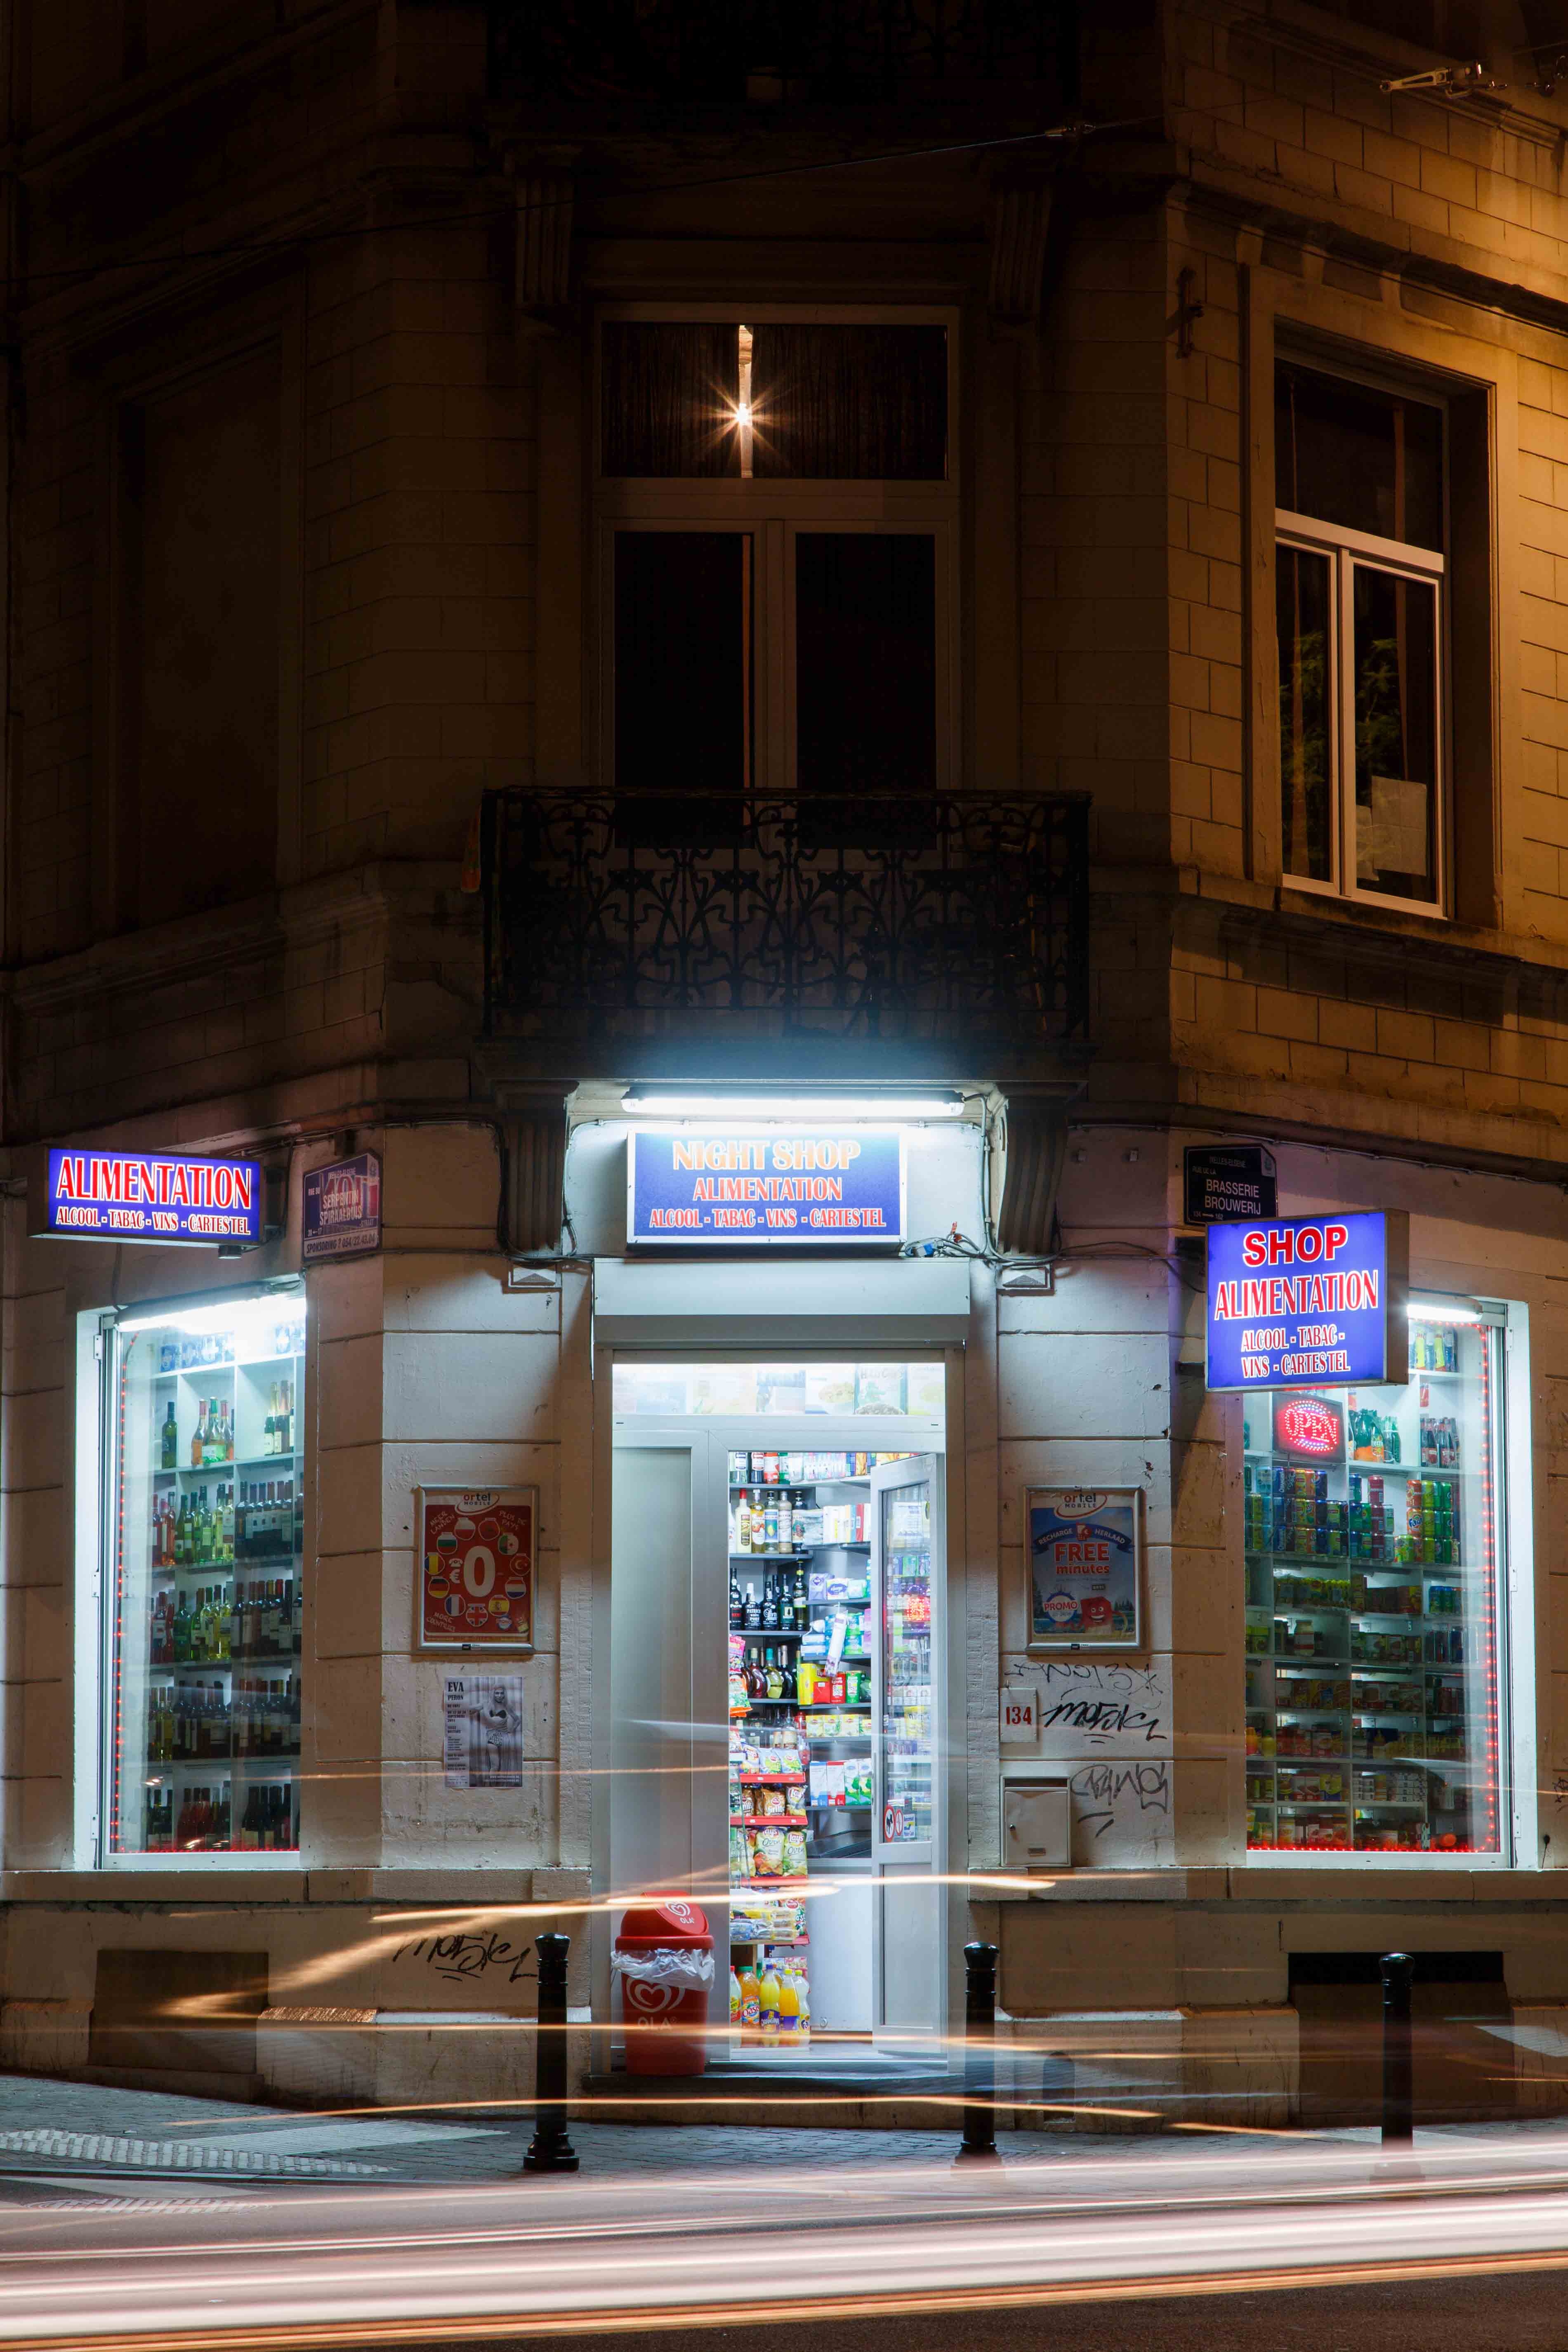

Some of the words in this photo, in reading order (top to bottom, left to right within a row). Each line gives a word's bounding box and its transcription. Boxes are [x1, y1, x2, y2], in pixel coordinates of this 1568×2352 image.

[673, 1139, 773, 1170] NIGHT
[773, 1139, 861, 1170] SHOP
[56, 1156, 251, 1210] ALIMENTATION
[693, 1176, 842, 1201] ALIMENTATION
[1206, 1179, 1259, 1198] BRASSERIE
[323, 1189, 359, 1209] SERPENTIN
[1205, 1195, 1261, 1215] BROUWERIJ
[56, 1206, 101, 1226] ALCOOL
[109, 1210, 144, 1228] TABAC
[152, 1212, 179, 1231] VINS
[649, 1208, 703, 1228] ALCOOL
[712, 1208, 756, 1228] TABAC
[766, 1208, 797, 1228] VINS
[307, 1239, 337, 1254] SPONSORING
[1242, 1224, 1349, 1267] SHOP
[1214, 1269, 1379, 1321] ALIMENTATION
[1240, 1327, 1289, 1352] ALCOOL
[1297, 1324, 1337, 1348] TABAC
[1241, 1355, 1270, 1378] VINS
[1285, 1408, 1338, 1444] OPEN
[463, 1493, 491, 1501] ortel
[1064, 1493, 1096, 1503] ortel
[498, 1510, 516, 1521] PLUS
[1038, 1528, 1073, 1545] RECHARGE
[1095, 1528, 1126, 1544] HERLAAD
[1054, 1542, 1110, 1562] FREE
[463, 1545, 495, 1597] 0
[1056, 1563, 1110, 1575] minutes
[1044, 1601, 1078, 1611] PROMO
[434, 1611, 453, 1624] MORE
[448, 1682, 464, 1692] EVA
[1006, 1706, 1032, 1724] 134
[762, 1838, 781, 1847] Oven
[788, 1846, 805, 1855] Oven
[742, 2004, 759, 2017] Oasis
